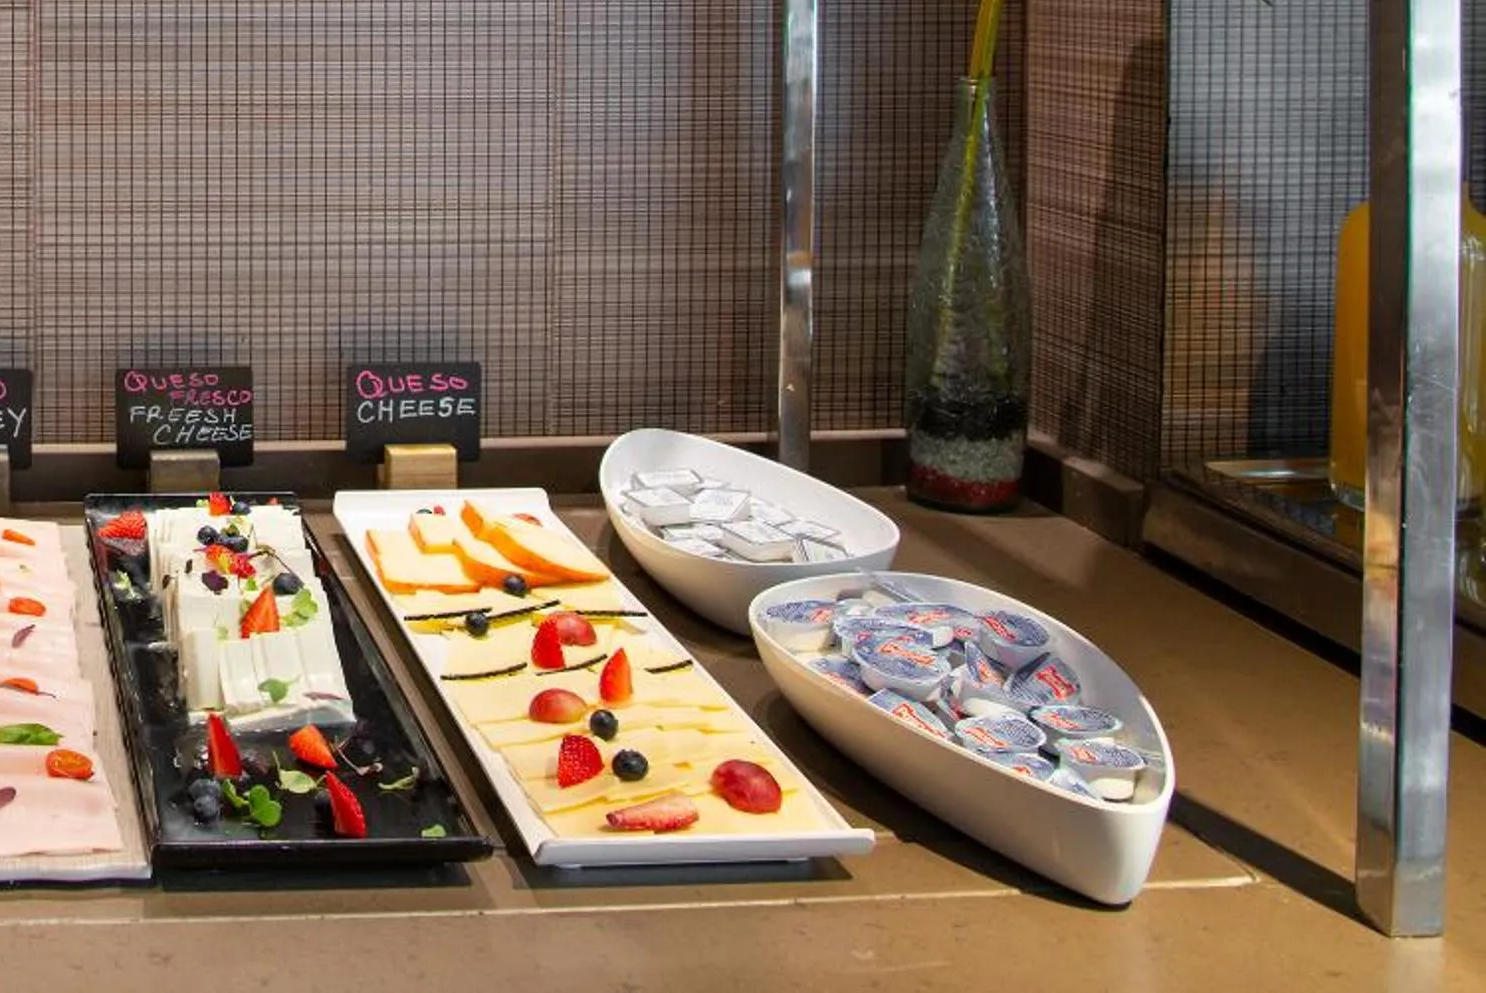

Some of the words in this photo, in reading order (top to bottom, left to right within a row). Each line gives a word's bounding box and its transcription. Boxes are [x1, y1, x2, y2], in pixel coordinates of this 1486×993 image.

[124, 370, 219, 392] QUESO
[356, 370, 469, 399] QUESO
[357, 396, 476, 424] CHEESE
[153, 423, 253, 445] CHEESE
